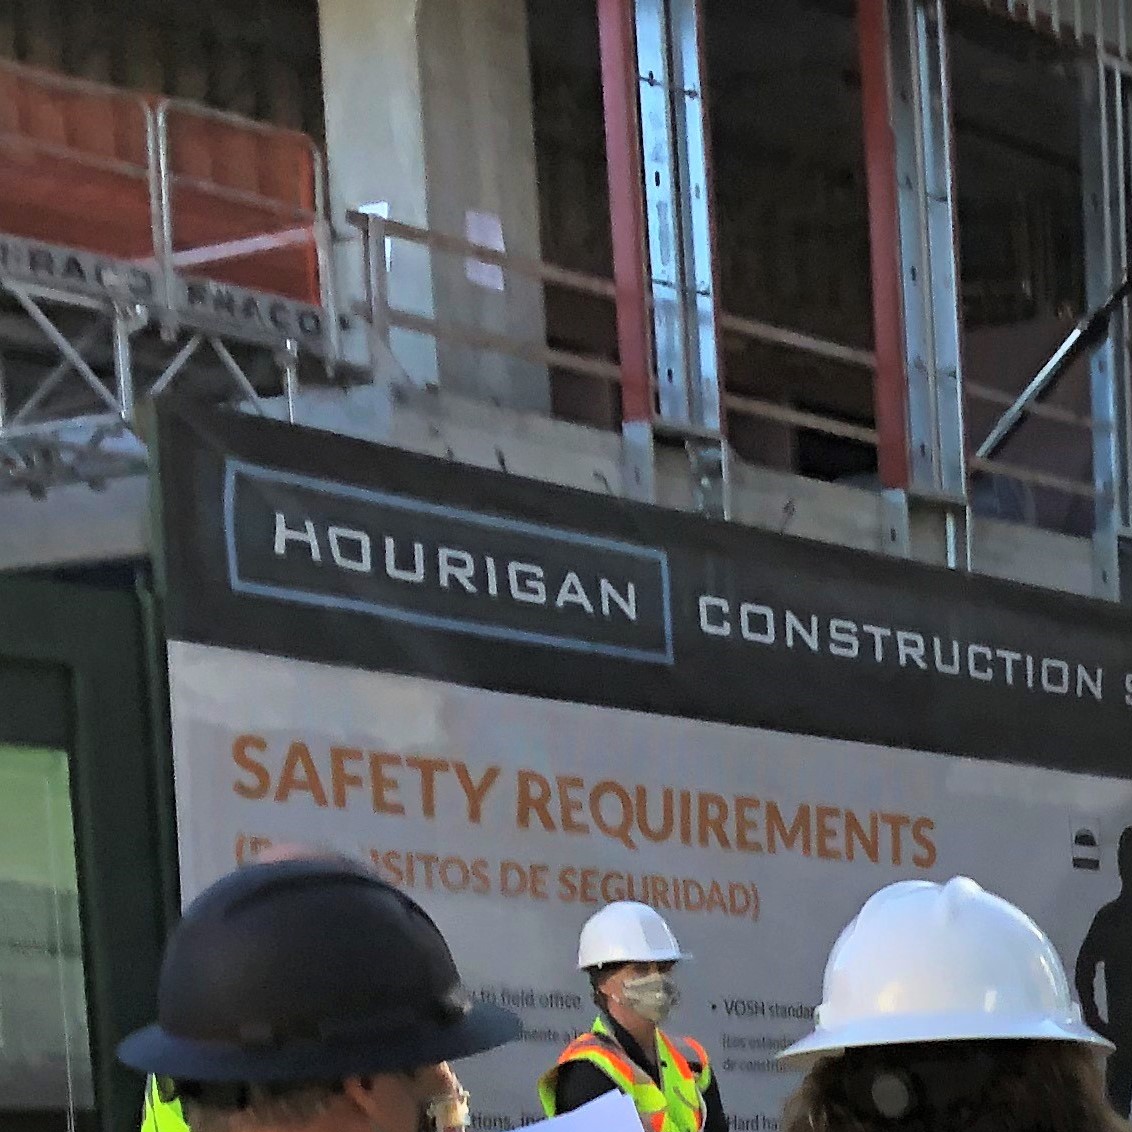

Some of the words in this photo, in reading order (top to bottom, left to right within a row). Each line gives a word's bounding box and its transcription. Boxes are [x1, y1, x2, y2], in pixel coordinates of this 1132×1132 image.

[273, 511, 638, 622] HOURIGAN
[698, 594, 1104, 701] CONSTRUCTION
[231, 733, 501, 824] SAFETY
[515, 768, 938, 870] REQUIREMENTS
[500, 859, 550, 900] DE
[557, 864, 761, 922] SEGURIDAD)
[723, 999, 766, 1017] VOSH
